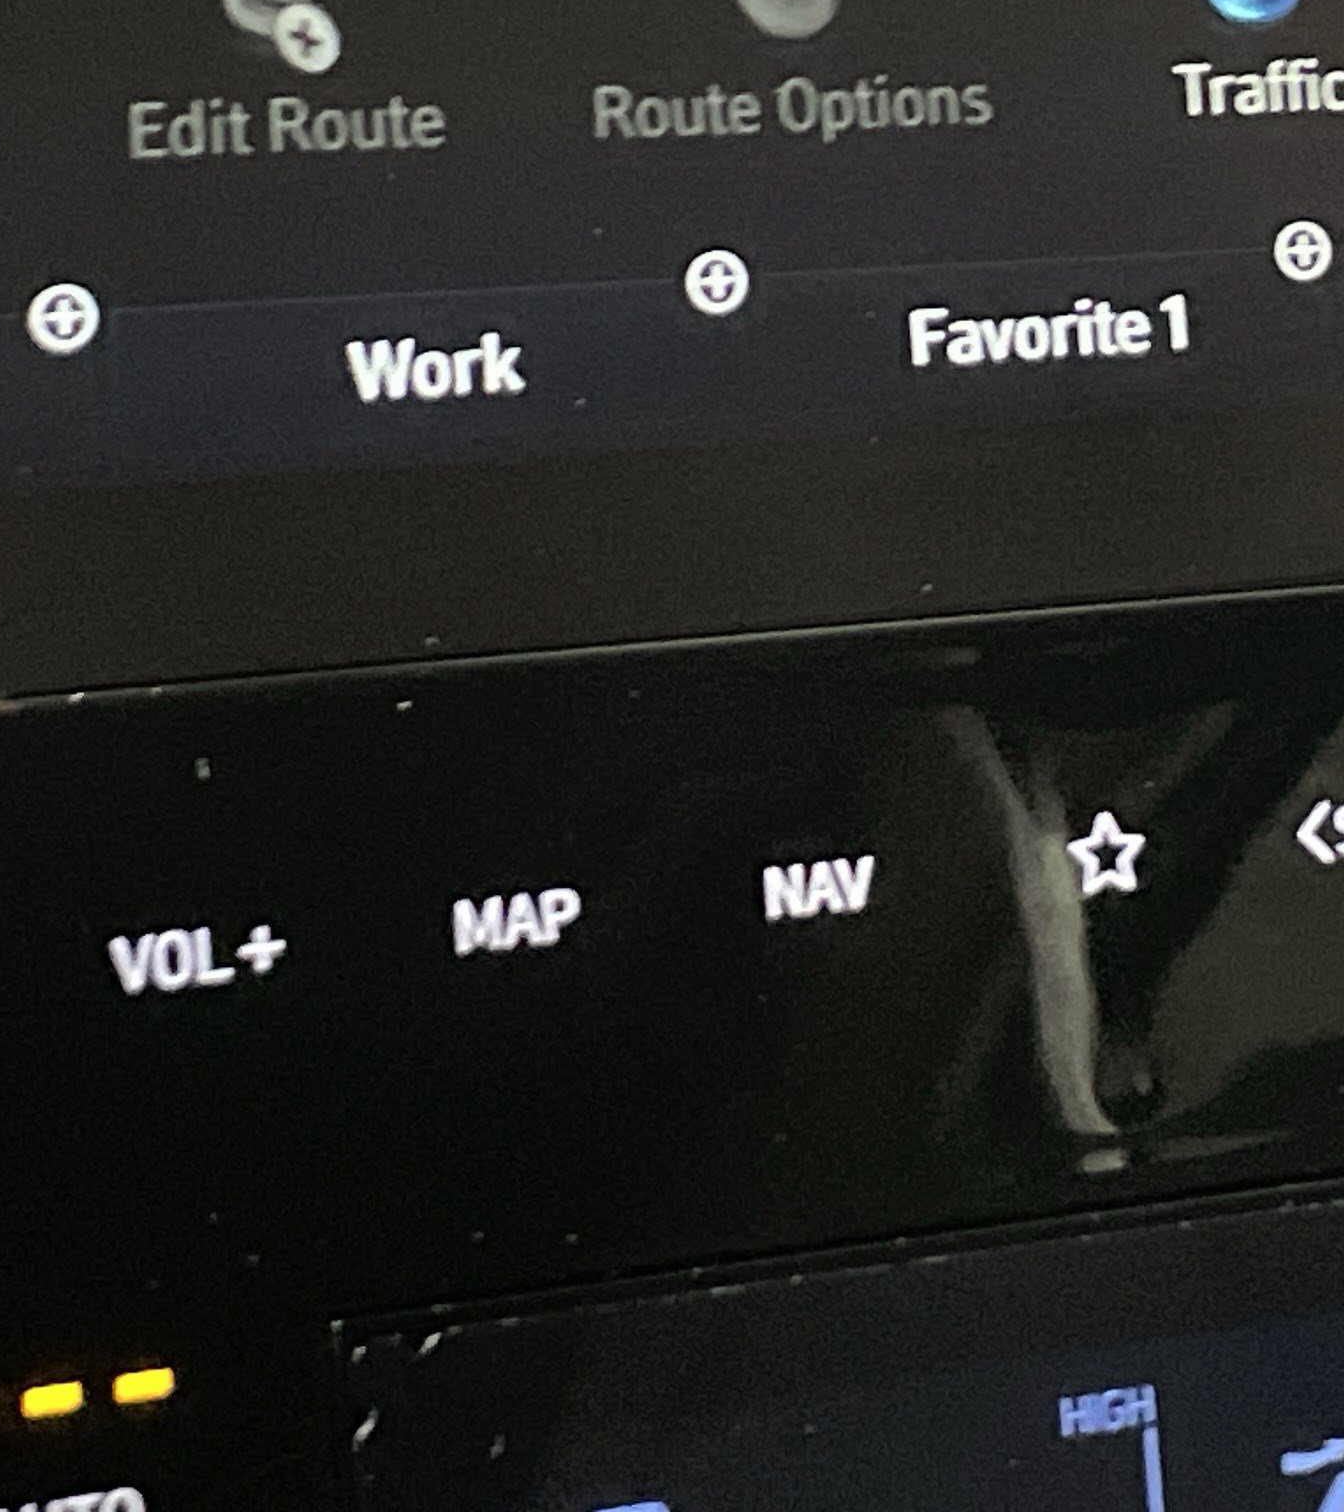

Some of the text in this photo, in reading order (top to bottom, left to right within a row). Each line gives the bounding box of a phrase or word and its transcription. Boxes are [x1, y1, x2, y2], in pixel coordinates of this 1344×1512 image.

[128, 95, 446, 160] Edit Route
[592, 73, 994, 144] Route Options
[908, 293, 1190, 367] Favorite 1
[345, 331, 527, 403] Work
[452, 887, 582, 955] MAP
[762, 854, 876, 921] NAV
[1060, 1384, 1155, 1437] HIGH
